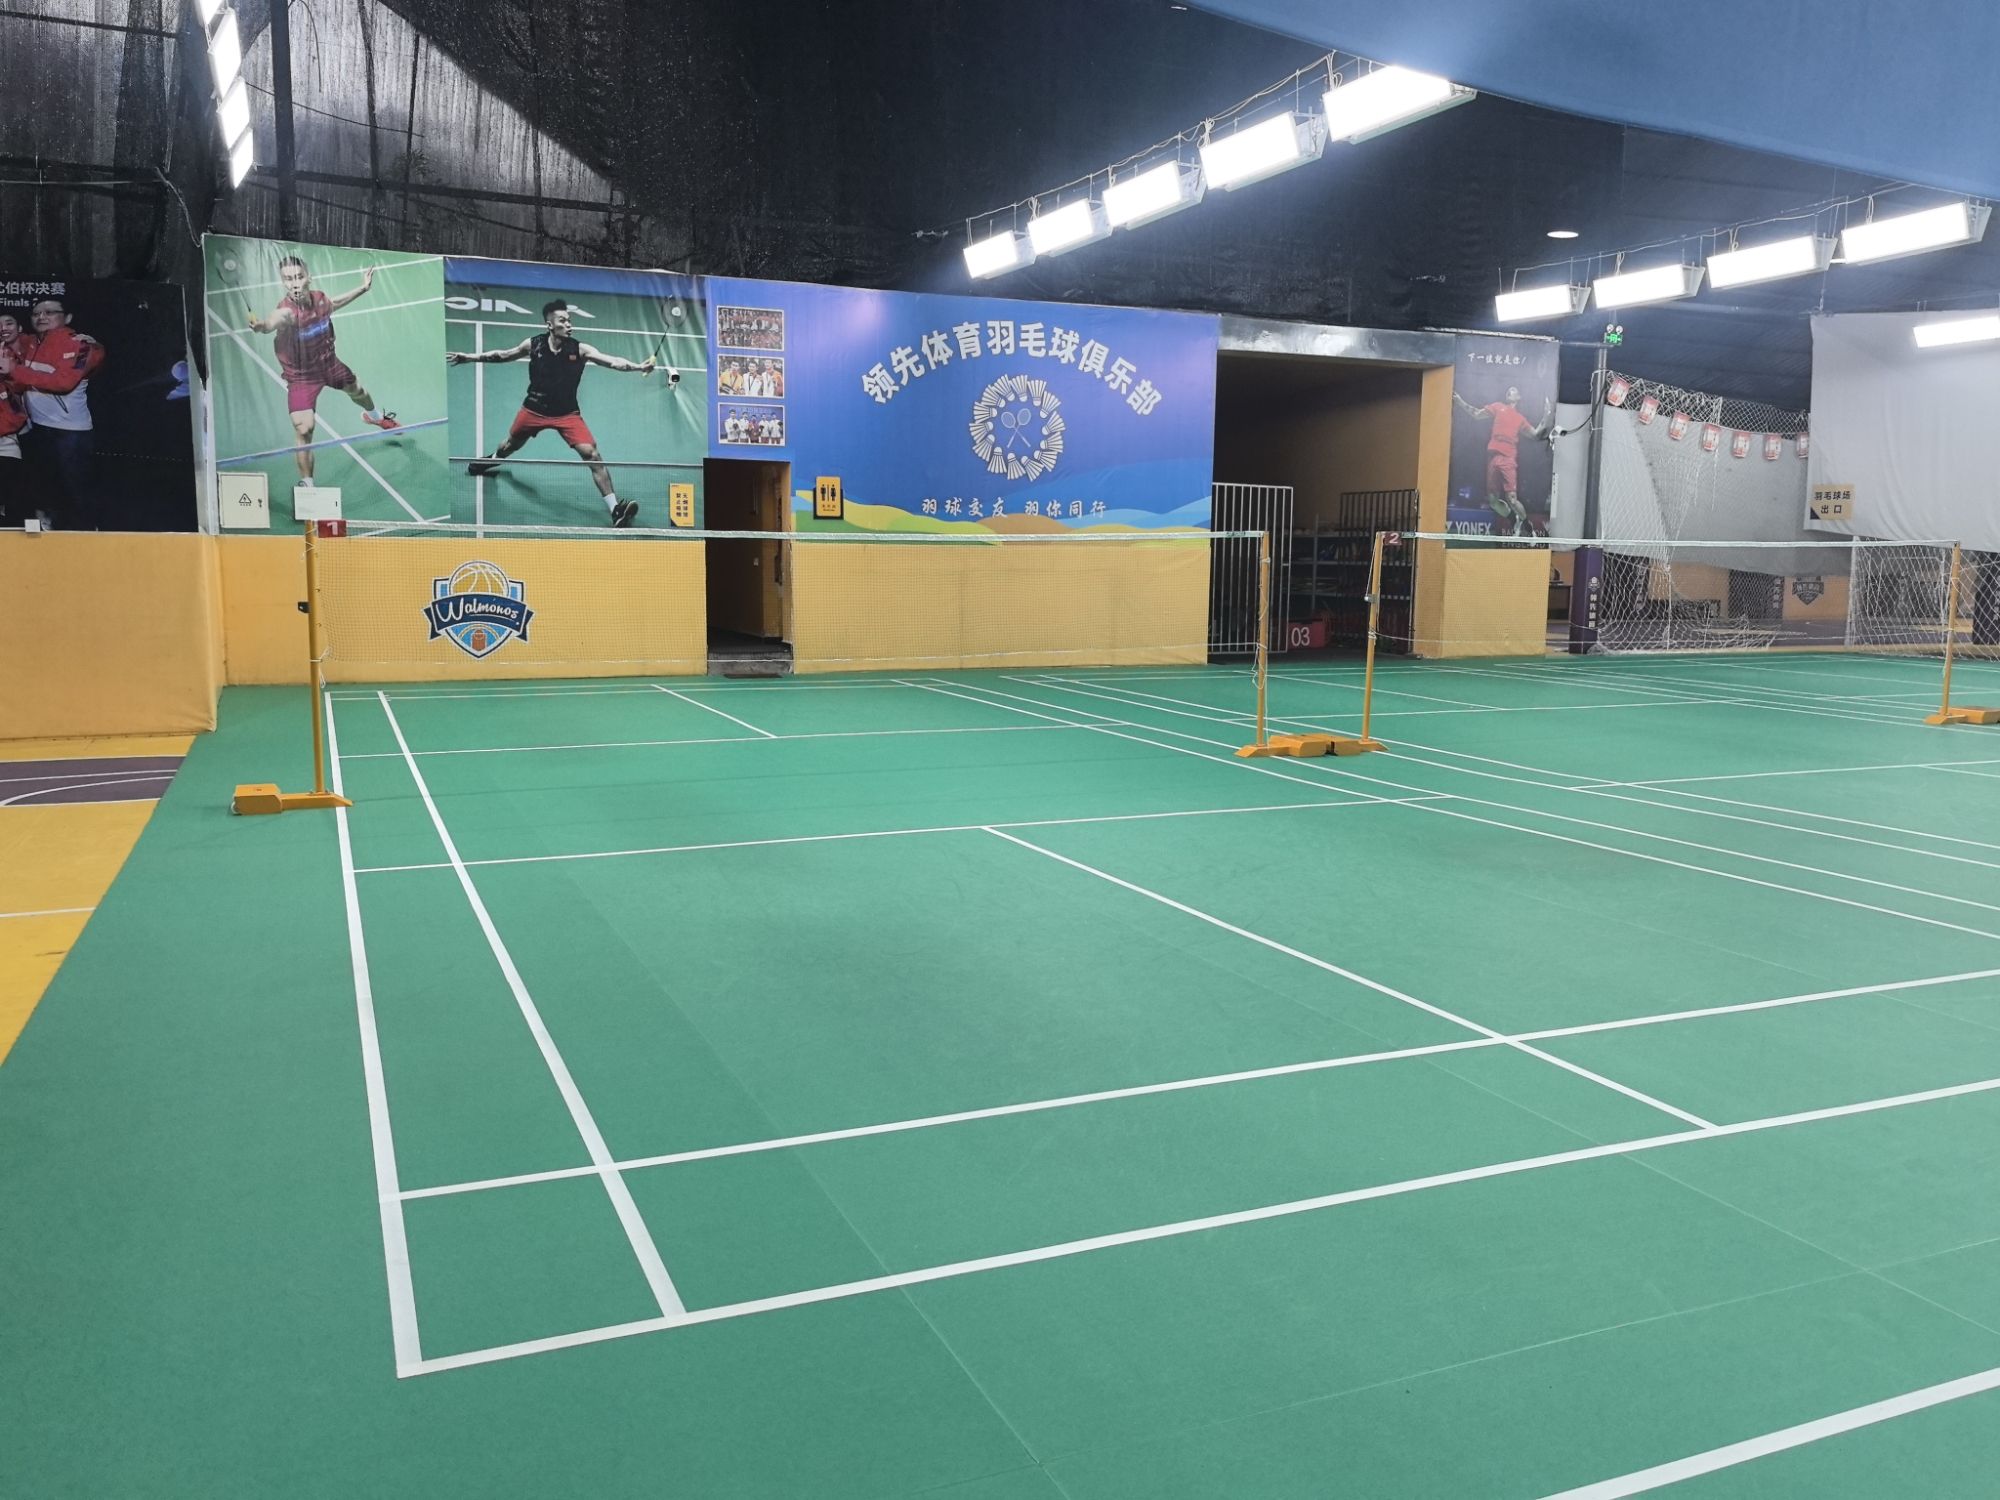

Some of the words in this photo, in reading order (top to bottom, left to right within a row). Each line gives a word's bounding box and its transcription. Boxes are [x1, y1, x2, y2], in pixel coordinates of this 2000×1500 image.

[861, 319, 1163, 417] 领先体育羽毛球俱乐部
[1814, 490, 1851, 501] 羽毛球场
[921, 496, 1008, 518] 羽球交友
[1024, 499, 1106, 518] 羽你同行
[1820, 504, 1842, 514] 出口
[326, 521, 338, 536] 1
[1455, 521, 1491, 536] YONEX
[1389, 532, 1400, 544] 2
[1290, 626, 1310, 647] 03
